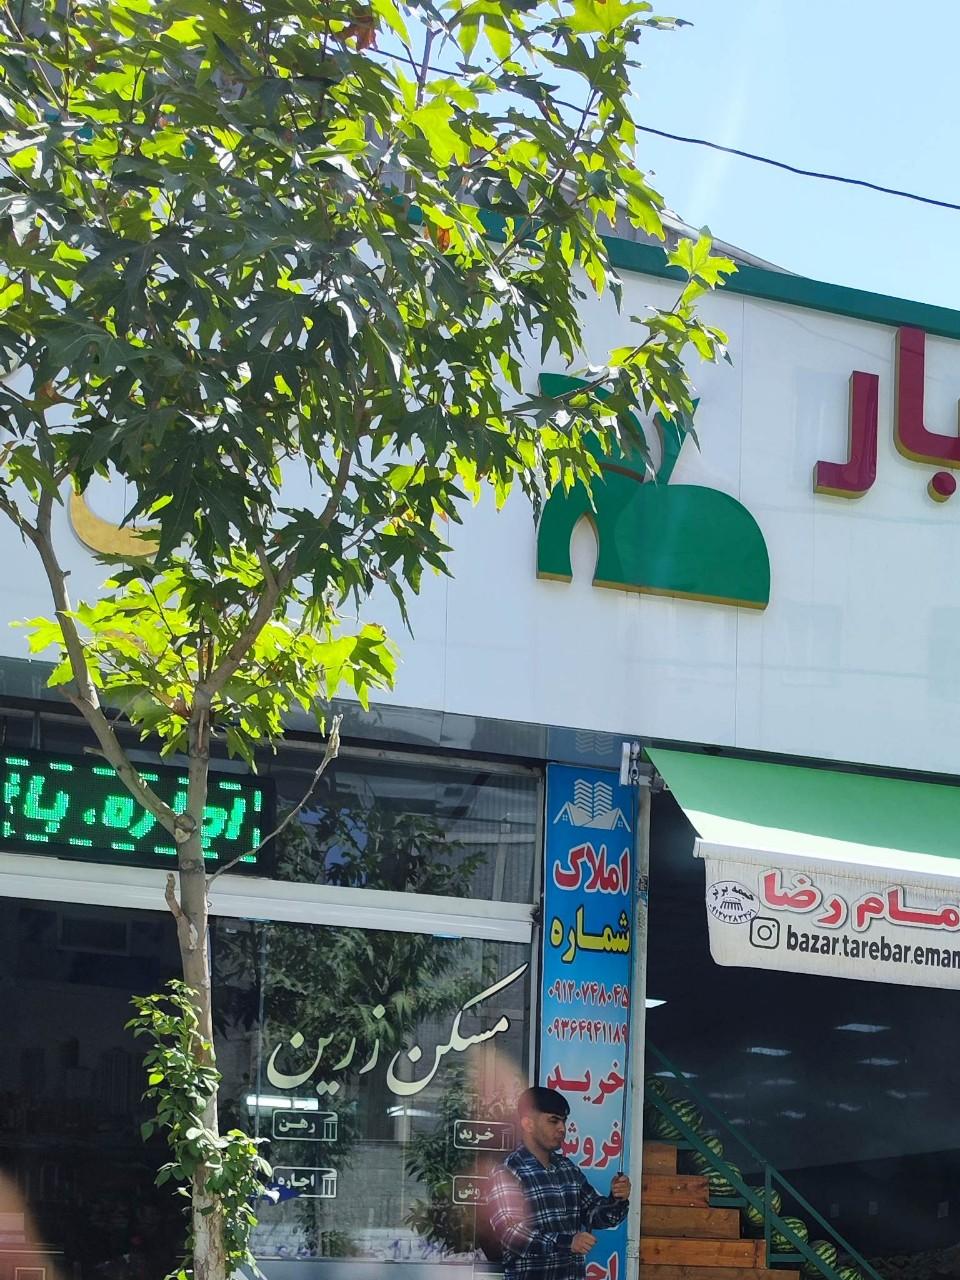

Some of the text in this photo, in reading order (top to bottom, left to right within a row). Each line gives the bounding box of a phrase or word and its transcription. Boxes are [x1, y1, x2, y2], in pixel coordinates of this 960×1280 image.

[553, 841, 630, 896] املاک
[760, 868, 848, 929] رضا
[550, 904, 631, 965] شماره
[267, 962, 529, 1096] مسکن زرین
[546, 1059, 625, 1106] خرید
[278, 1117, 316, 1134] رهن
[458, 1127, 495, 1144] خرید
[277, 1172, 315, 1191] اجاره
